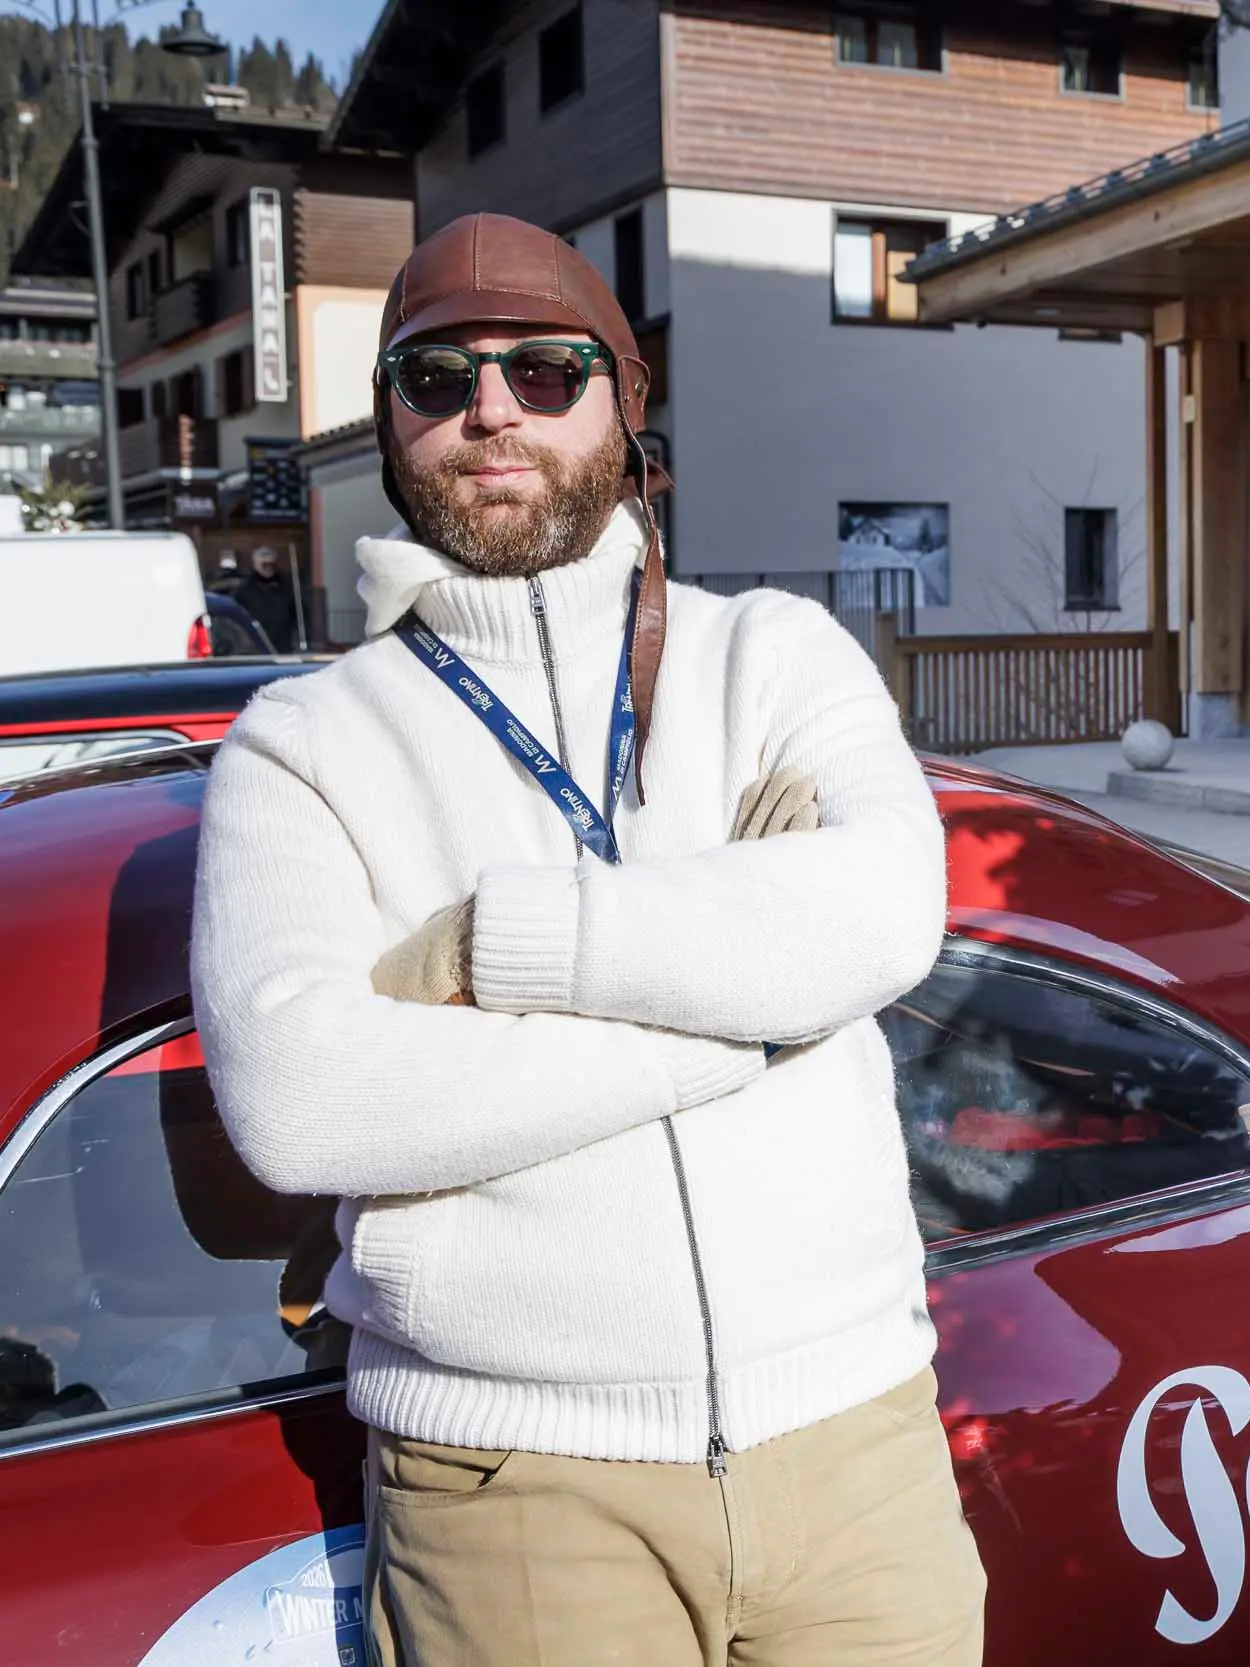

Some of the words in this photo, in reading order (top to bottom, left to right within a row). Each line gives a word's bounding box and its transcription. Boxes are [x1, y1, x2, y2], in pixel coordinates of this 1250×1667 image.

[507, 727, 535, 757] MADONNA
[617, 734, 627, 771] MADONNA
[560, 788, 594, 831] TRENTINO
[275, 1590, 349, 1638] WINTER
